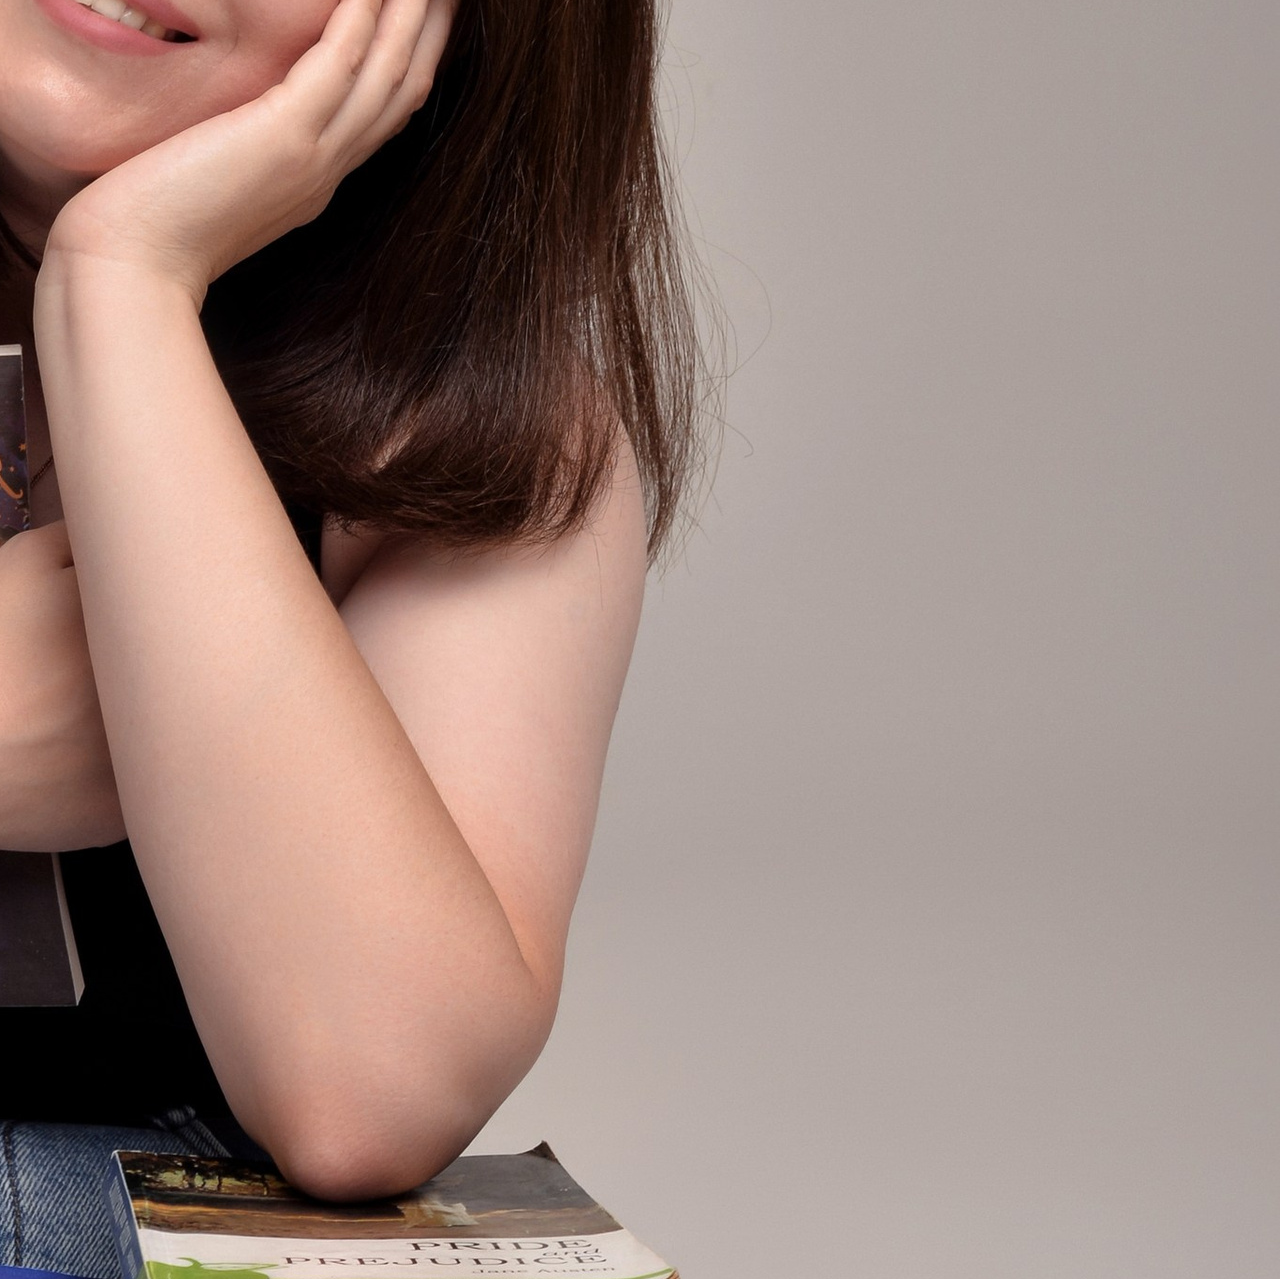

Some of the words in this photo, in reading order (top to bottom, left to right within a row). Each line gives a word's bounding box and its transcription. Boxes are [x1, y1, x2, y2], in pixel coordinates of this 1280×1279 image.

[409, 1239, 593, 1251] PRIDE
[542, 1247, 601, 1257] and
[284, 1254, 607, 1266] PREJUDICE
